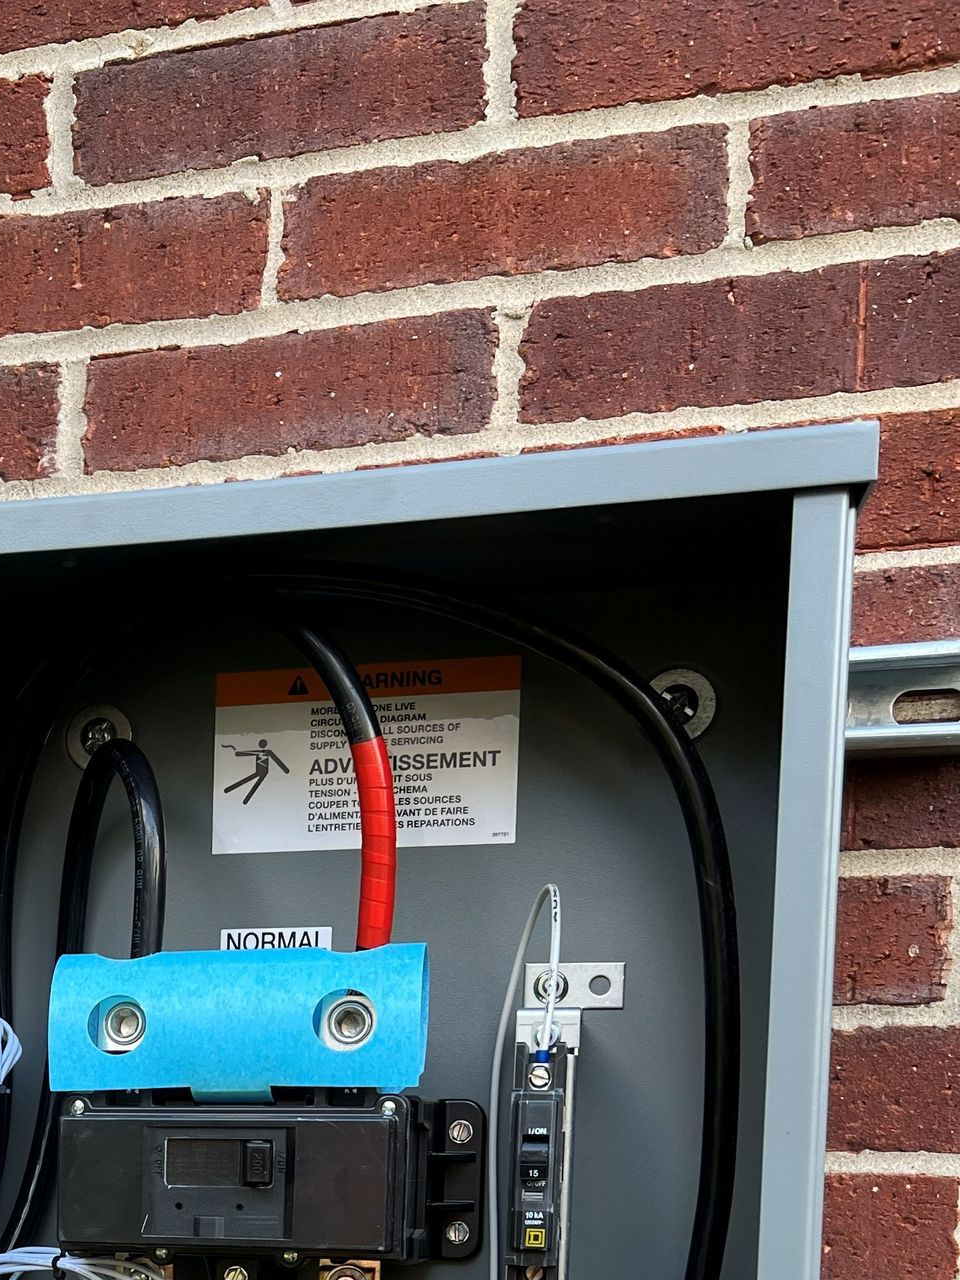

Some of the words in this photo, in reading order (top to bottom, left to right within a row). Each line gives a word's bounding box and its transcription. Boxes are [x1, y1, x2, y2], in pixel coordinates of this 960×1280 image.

[362, 669, 444, 690] ARNING
[311, 706, 340, 716] MORE
[394, 702, 416, 711] LIVE
[310, 717, 344, 727] CIRCU
[380, 713, 427, 724] DIAGRAM
[310, 728, 347, 739] DISCON
[396, 723, 445, 735] SOURCES
[447, 722, 462, 732] OF
[310, 741, 347, 751] SUPPLY
[390, 735, 444, 747] SERVICING
[308, 778, 335, 787] PLUS
[405, 773, 433, 782] SOUS
[308, 788, 351, 798] TENSION
[392, 785, 428, 795] CHEMA
[308, 800, 349, 810] COUPER
[413, 795, 462, 806] SOURCES
[424, 807, 438, 816] DE
[440, 806, 469, 816] FAIRE
[307, 822, 361, 833] L'ENTRETIE
[406, 817, 476, 829] REPARATIONS
[528, 1169, 539, 1177] 15
[525, 1211, 534, 1219] 10
